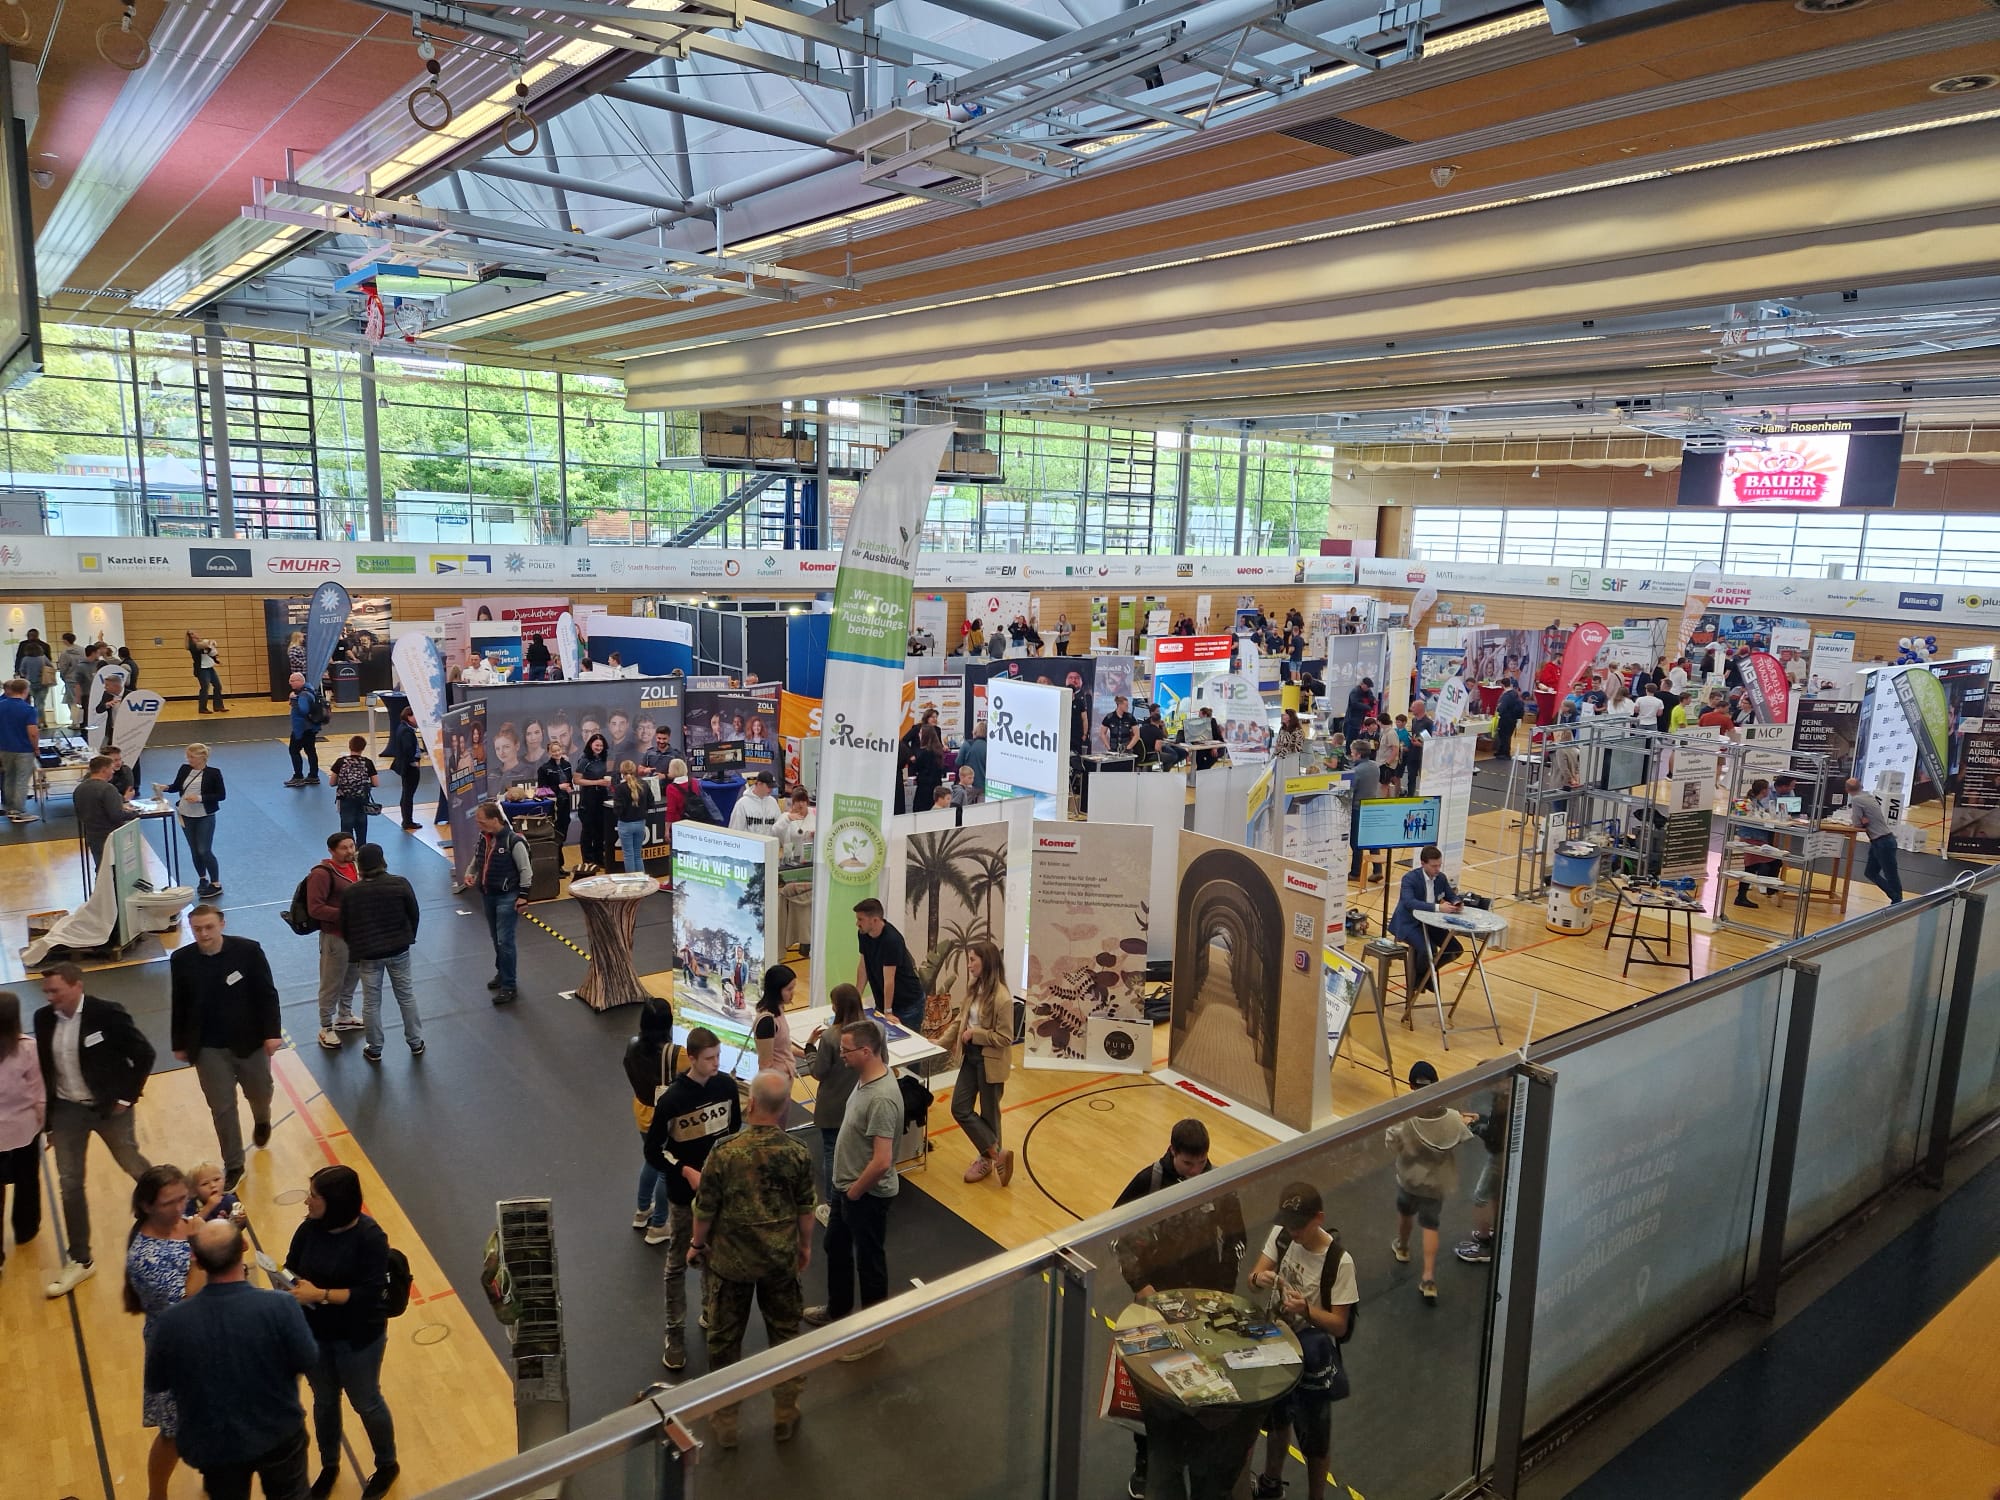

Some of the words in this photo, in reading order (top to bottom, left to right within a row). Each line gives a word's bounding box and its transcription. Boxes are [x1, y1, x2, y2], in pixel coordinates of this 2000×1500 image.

[1790, 421, 1852, 433] Rosenheim
[1745, 474, 1817, 488] BAUER
[1772, 488, 1817, 496] HANDWERK
[857, 539, 897, 555] Initiative
[107, 556, 147, 565] Kanzlei
[149, 556, 169, 564] EFA
[279, 559, 330, 572] MUHR
[862, 550, 910, 570] Ausbildung
[800, 561, 837, 571] Komar
[1001, 565, 1017, 576] EM
[1074, 566, 1093, 576] MCP
[1177, 563, 1193, 571] ZOLL
[1601, 577, 1629, 592] StiF
[1726, 588, 1752, 596] DEINE
[1710, 596, 1751, 606] KUNFT
[1902, 597, 1928, 605] Allianz
[872, 595, 905, 619] Top-
[319, 615, 342, 624] POLIZEI
[501, 656, 520, 664] jetzt!
[640, 685, 678, 700] ZOLL
[757, 702, 775, 710] ZOLL
[1834, 702, 1859, 714] EM
[1801, 719, 1823, 727] DEINE
[997, 711, 1058, 753] Reichl
[1758, 727, 1783, 739] MCP
[1800, 726, 1835, 734] KARRIERE
[840, 723, 896, 753] Reichl
[1970, 740, 1994, 748] DEINE
[838, 798, 878, 810] INITIATIVE
[677, 830, 698, 841] Blumen
[703, 836, 723, 847] Garten
[723, 840, 741, 849] Reichl
[1039, 838, 1076, 848] Komar
[677, 852, 710, 872] EINE/R
[712, 862, 731, 877] WIE
[733, 865, 748, 880] DU
[1287, 875, 1318, 891] Komar
[1105, 1040, 1133, 1050] PURE
